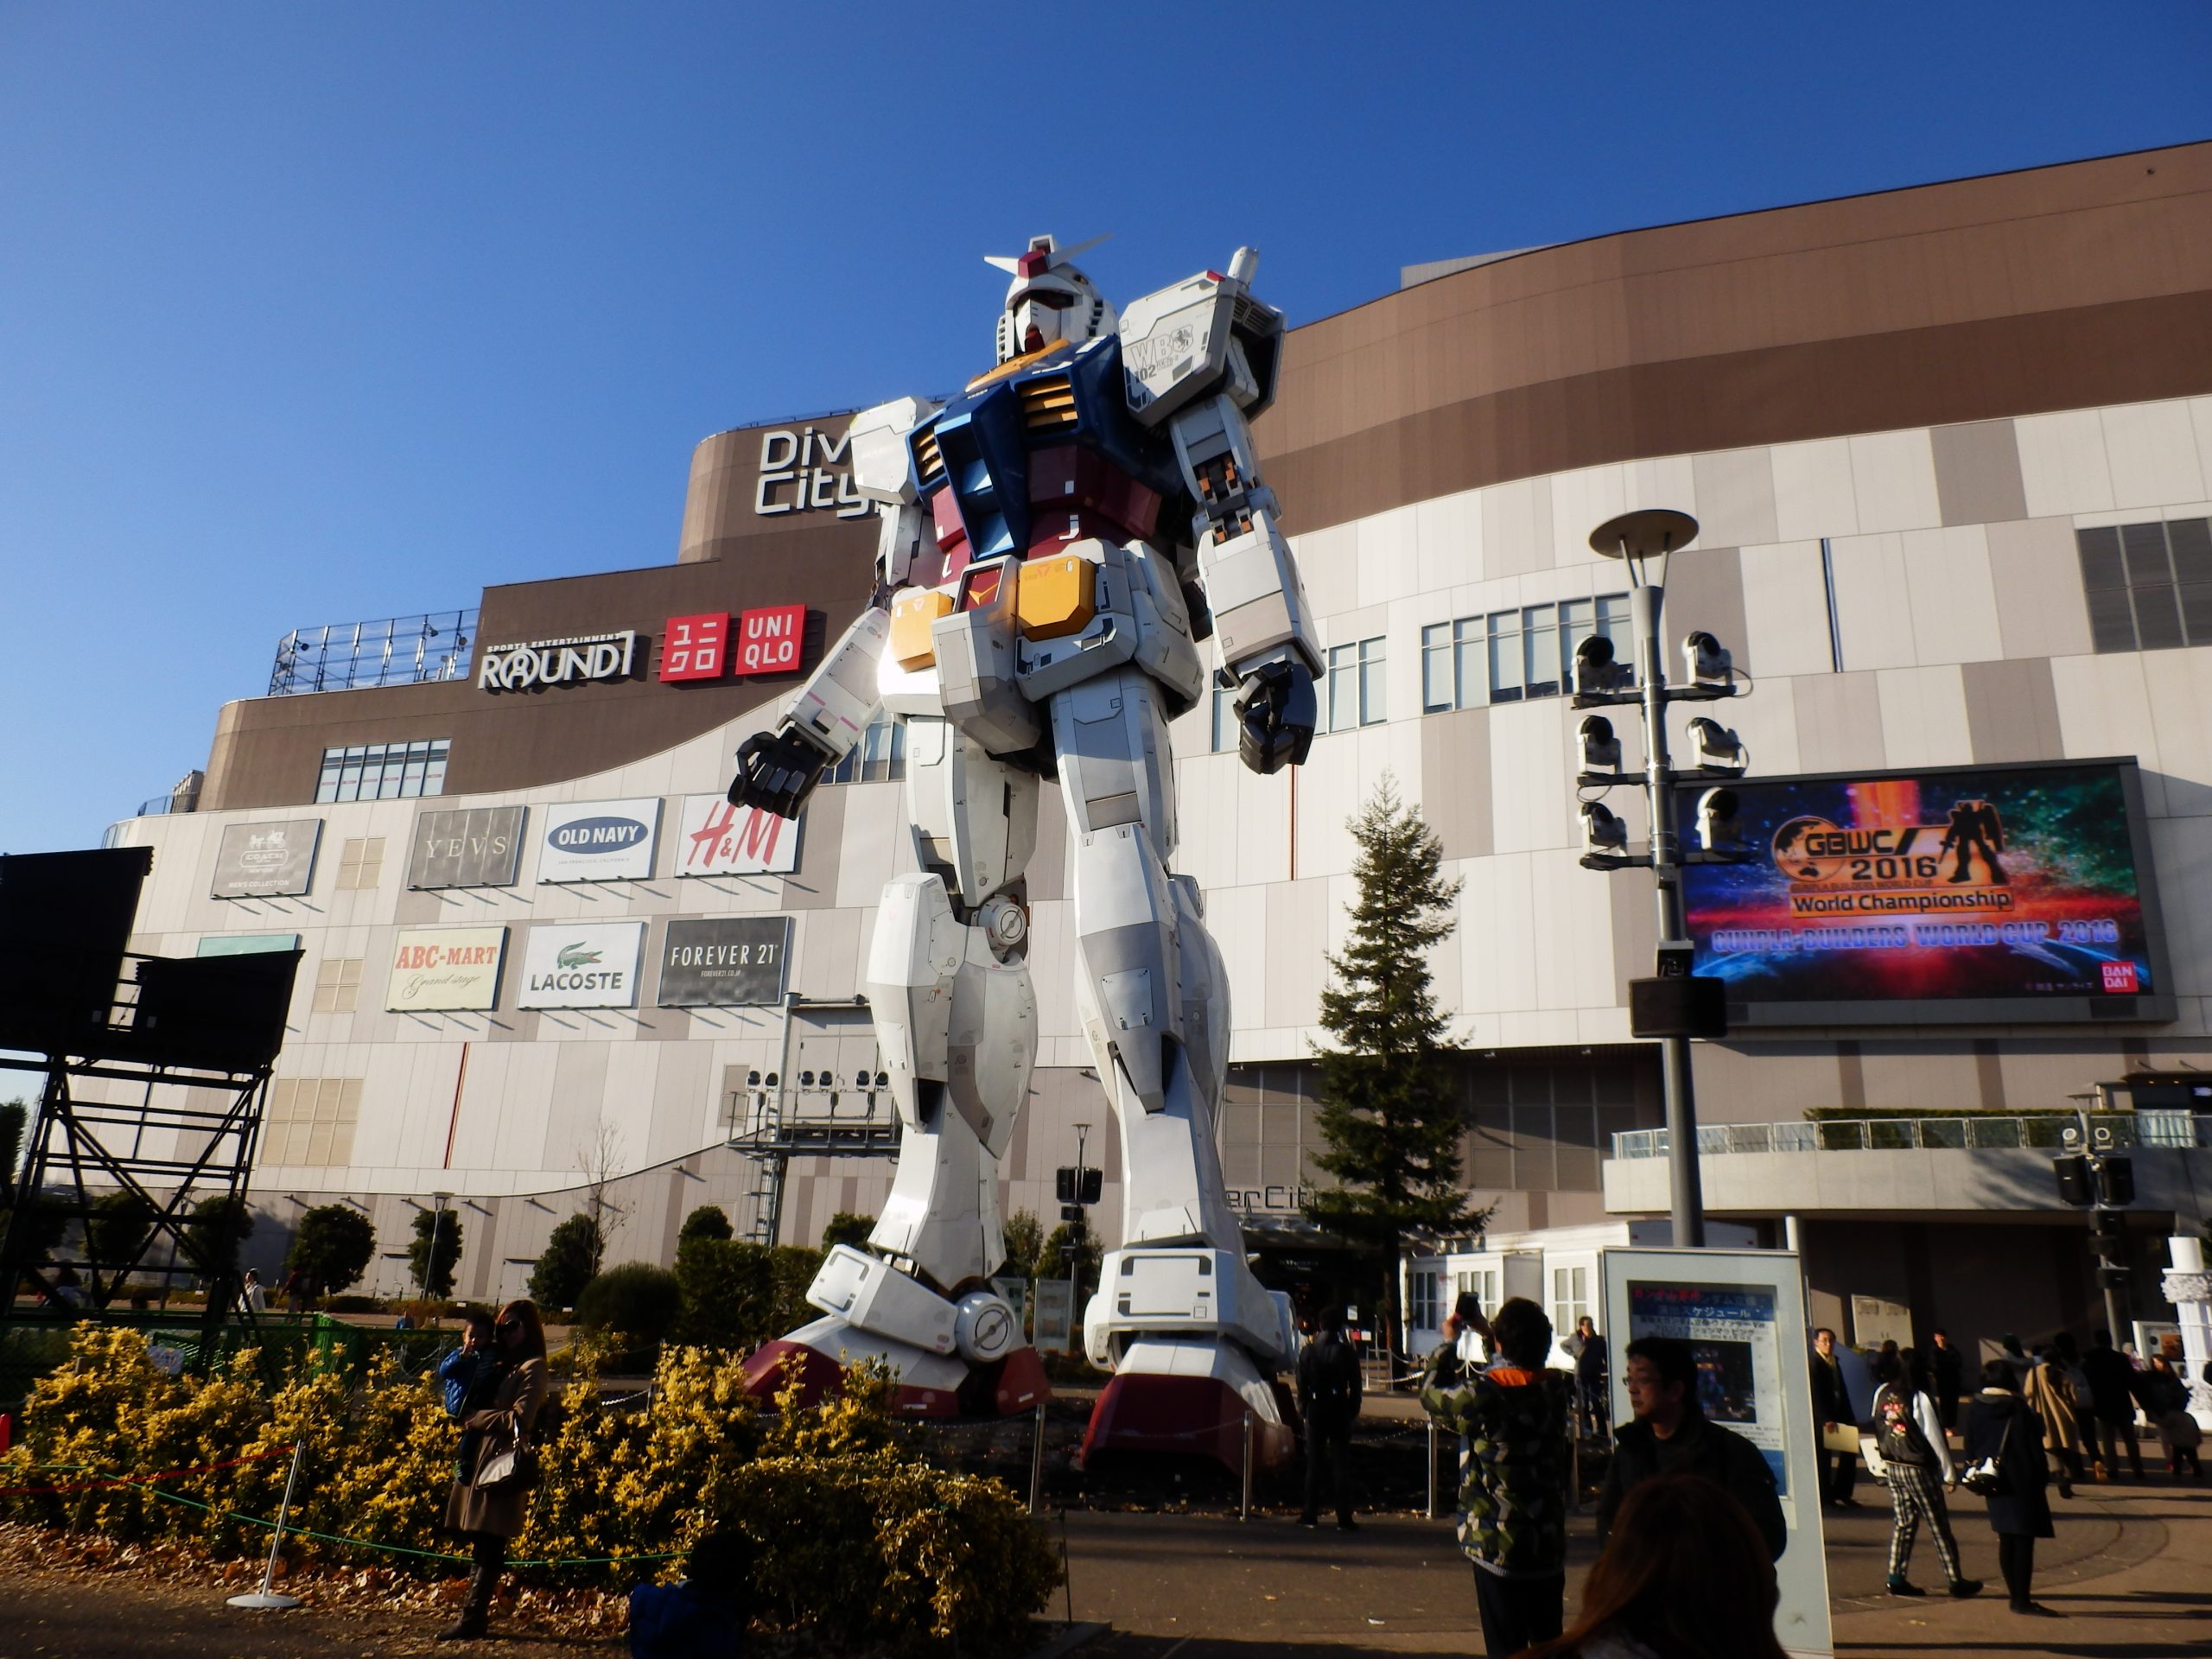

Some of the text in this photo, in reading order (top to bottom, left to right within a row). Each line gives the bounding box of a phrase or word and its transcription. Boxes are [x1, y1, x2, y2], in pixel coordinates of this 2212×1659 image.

[760, 427, 851, 472] Div
[755, 467, 869, 518] City
[747, 614, 792, 639] UNI
[486, 632, 621, 653] SPORTS ENTERTAINMENT
[745, 640, 793, 669] QLO
[558, 825, 639, 847] OLD NAVY
[687, 801, 784, 868] H&M
[1805, 830, 1895, 856] GBWC
[426, 836, 507, 859] YEVS
[1851, 856, 1937, 880] 2016
[1793, 892, 2010, 912] World Championship
[395, 945, 498, 969] ABC-MART
[671, 945, 749, 967] FOREVER
[401, 974, 481, 1000] Grand stage
[531, 972, 623, 991] LACOSTE
